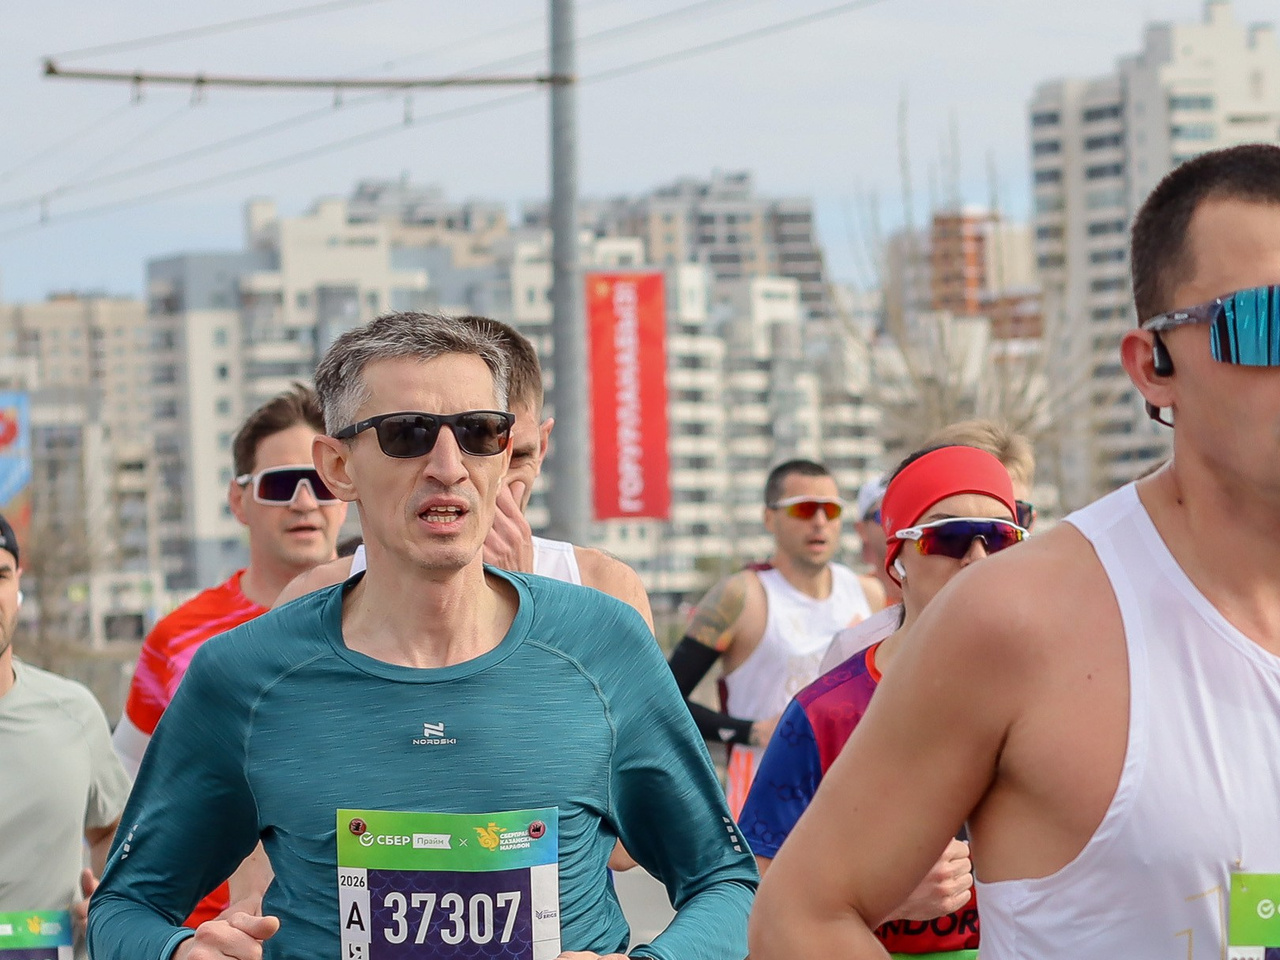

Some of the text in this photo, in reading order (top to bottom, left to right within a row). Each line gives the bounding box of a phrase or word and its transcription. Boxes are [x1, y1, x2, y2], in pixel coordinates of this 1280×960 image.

[376, 835, 444, 846] СБЕР Прайм
[340, 874, 366, 888] 2026
[384, 890, 522, 945] 37307
